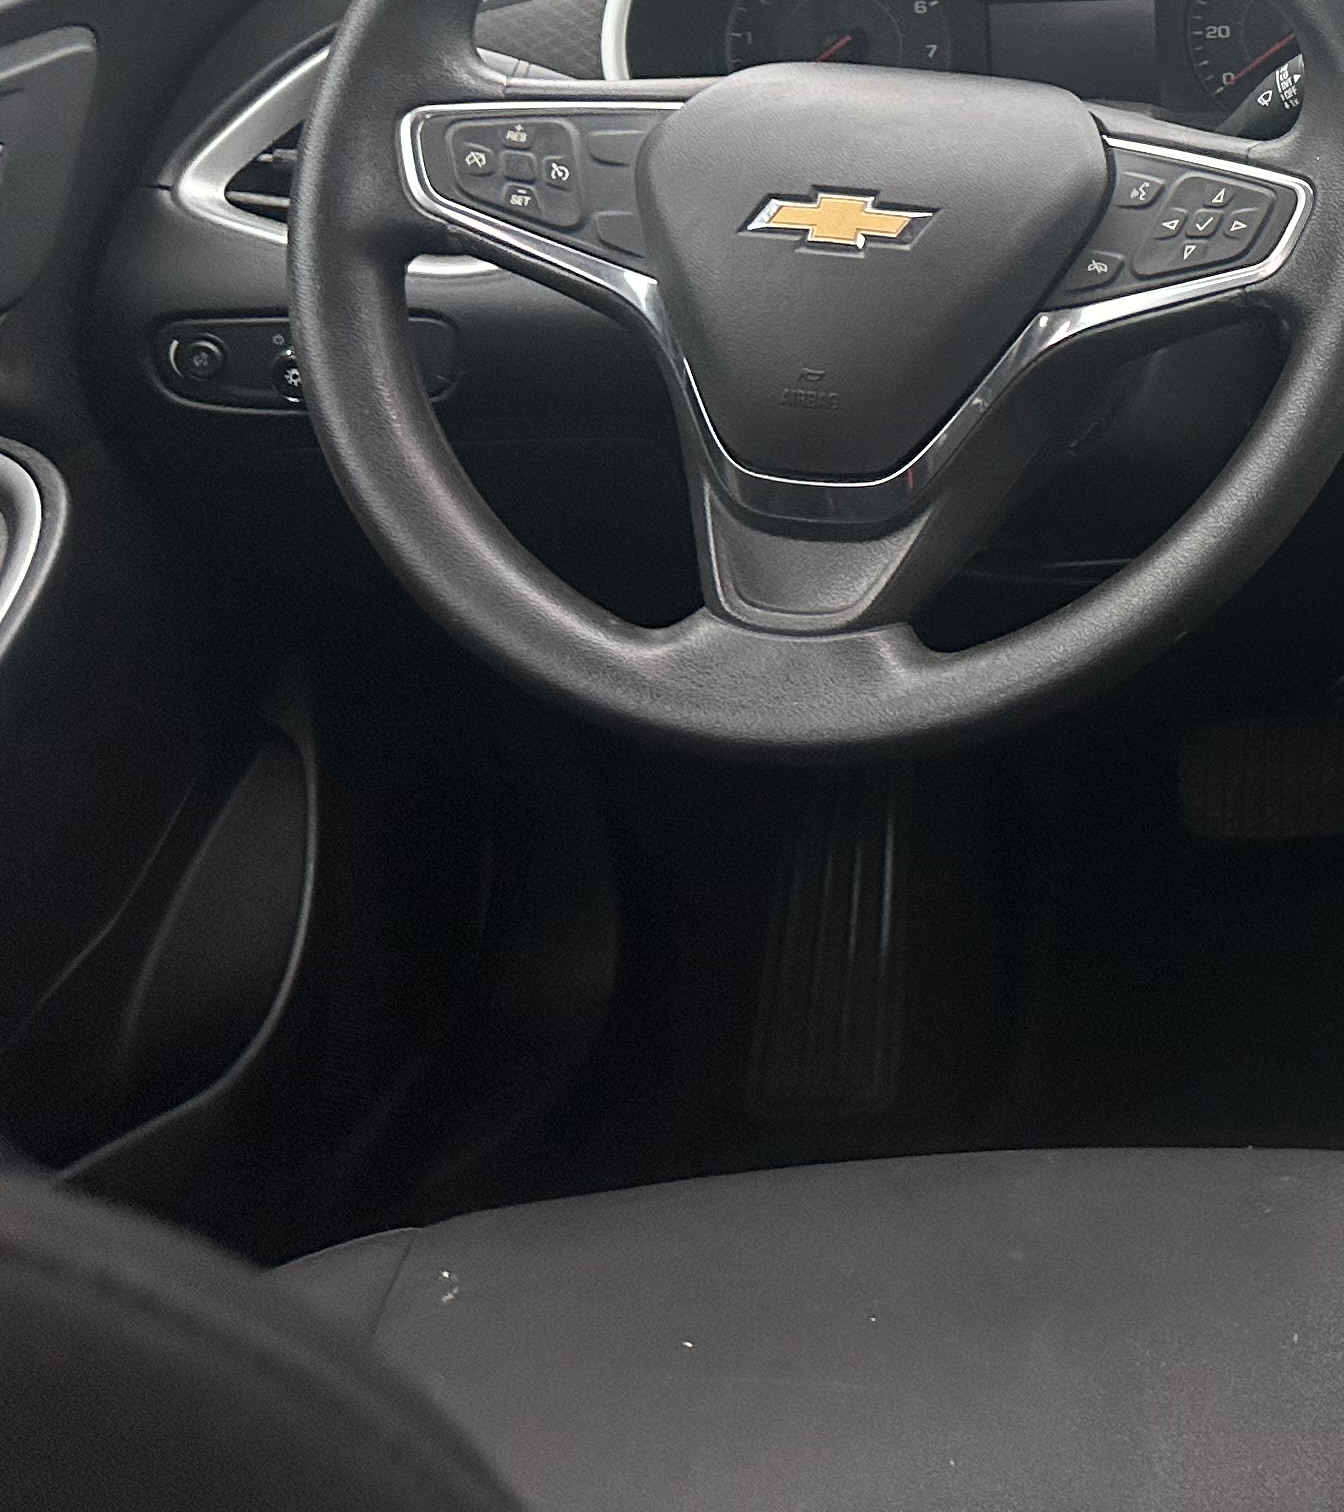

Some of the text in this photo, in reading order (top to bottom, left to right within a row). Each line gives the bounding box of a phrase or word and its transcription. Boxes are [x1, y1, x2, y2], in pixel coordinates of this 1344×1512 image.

[913, 0, 927, 14] 6
[1205, 25, 1231, 39] 20
[925, 44, 938, 58] 7
[1222, 72, 1235, 86] 0
[510, 194, 531, 207] SET
